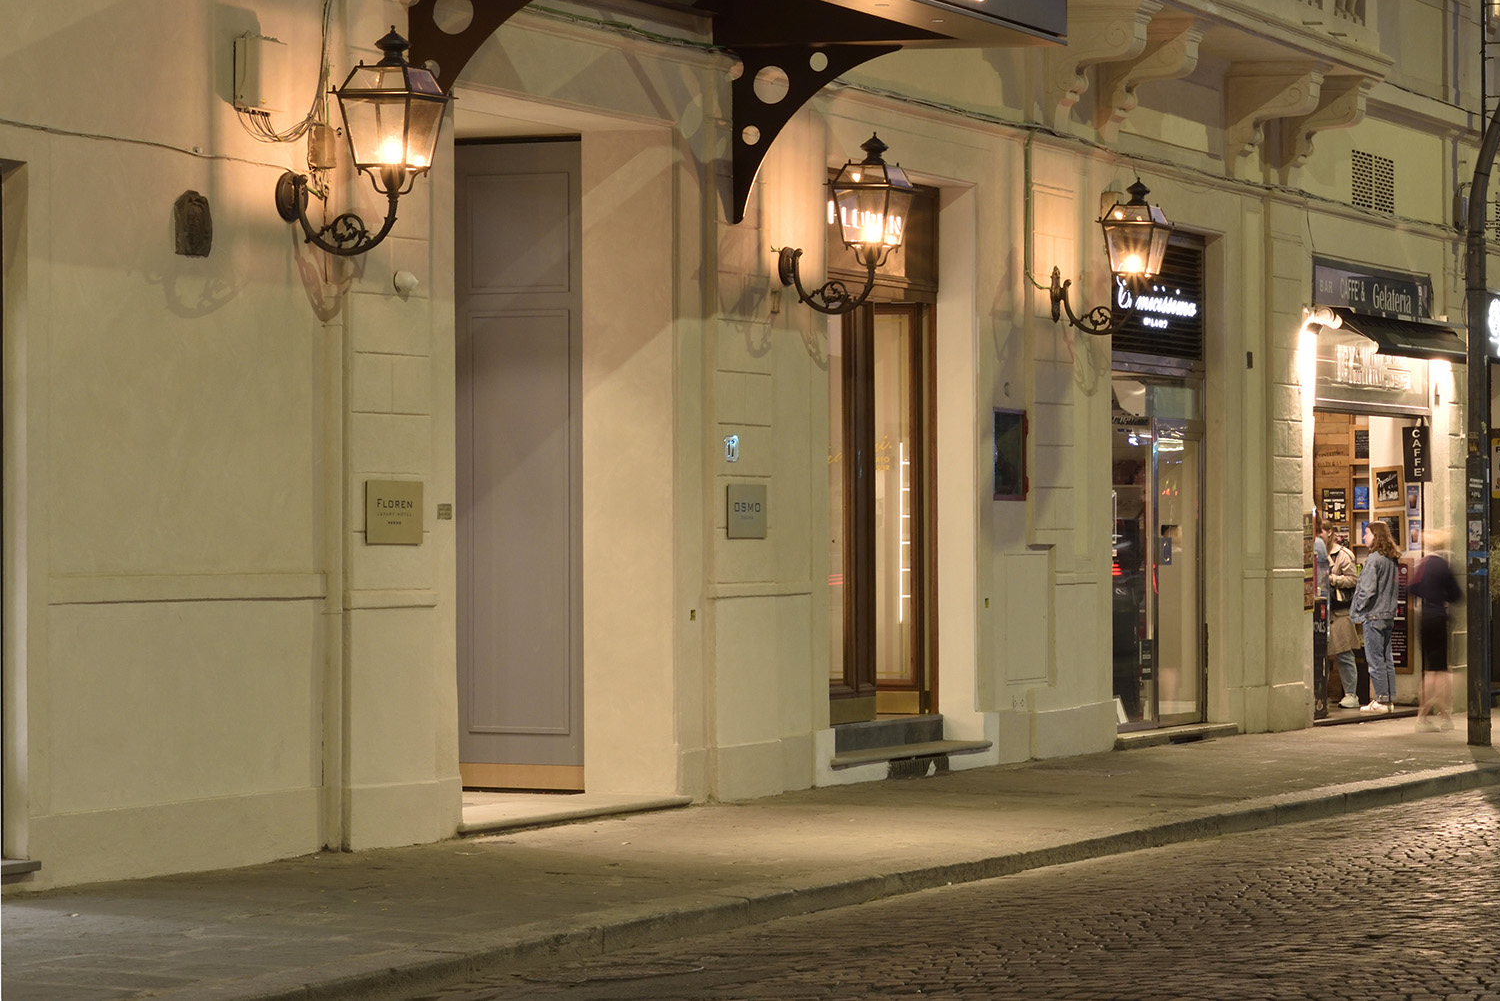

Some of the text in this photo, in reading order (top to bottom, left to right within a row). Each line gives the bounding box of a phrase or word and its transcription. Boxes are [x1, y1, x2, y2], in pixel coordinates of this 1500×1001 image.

[1319, 279, 1333, 294] BAR
[1372, 283, 1412, 314] Gelateria
[376, 498, 413, 508] FLOREN
[734, 502, 761, 513] OSMO
